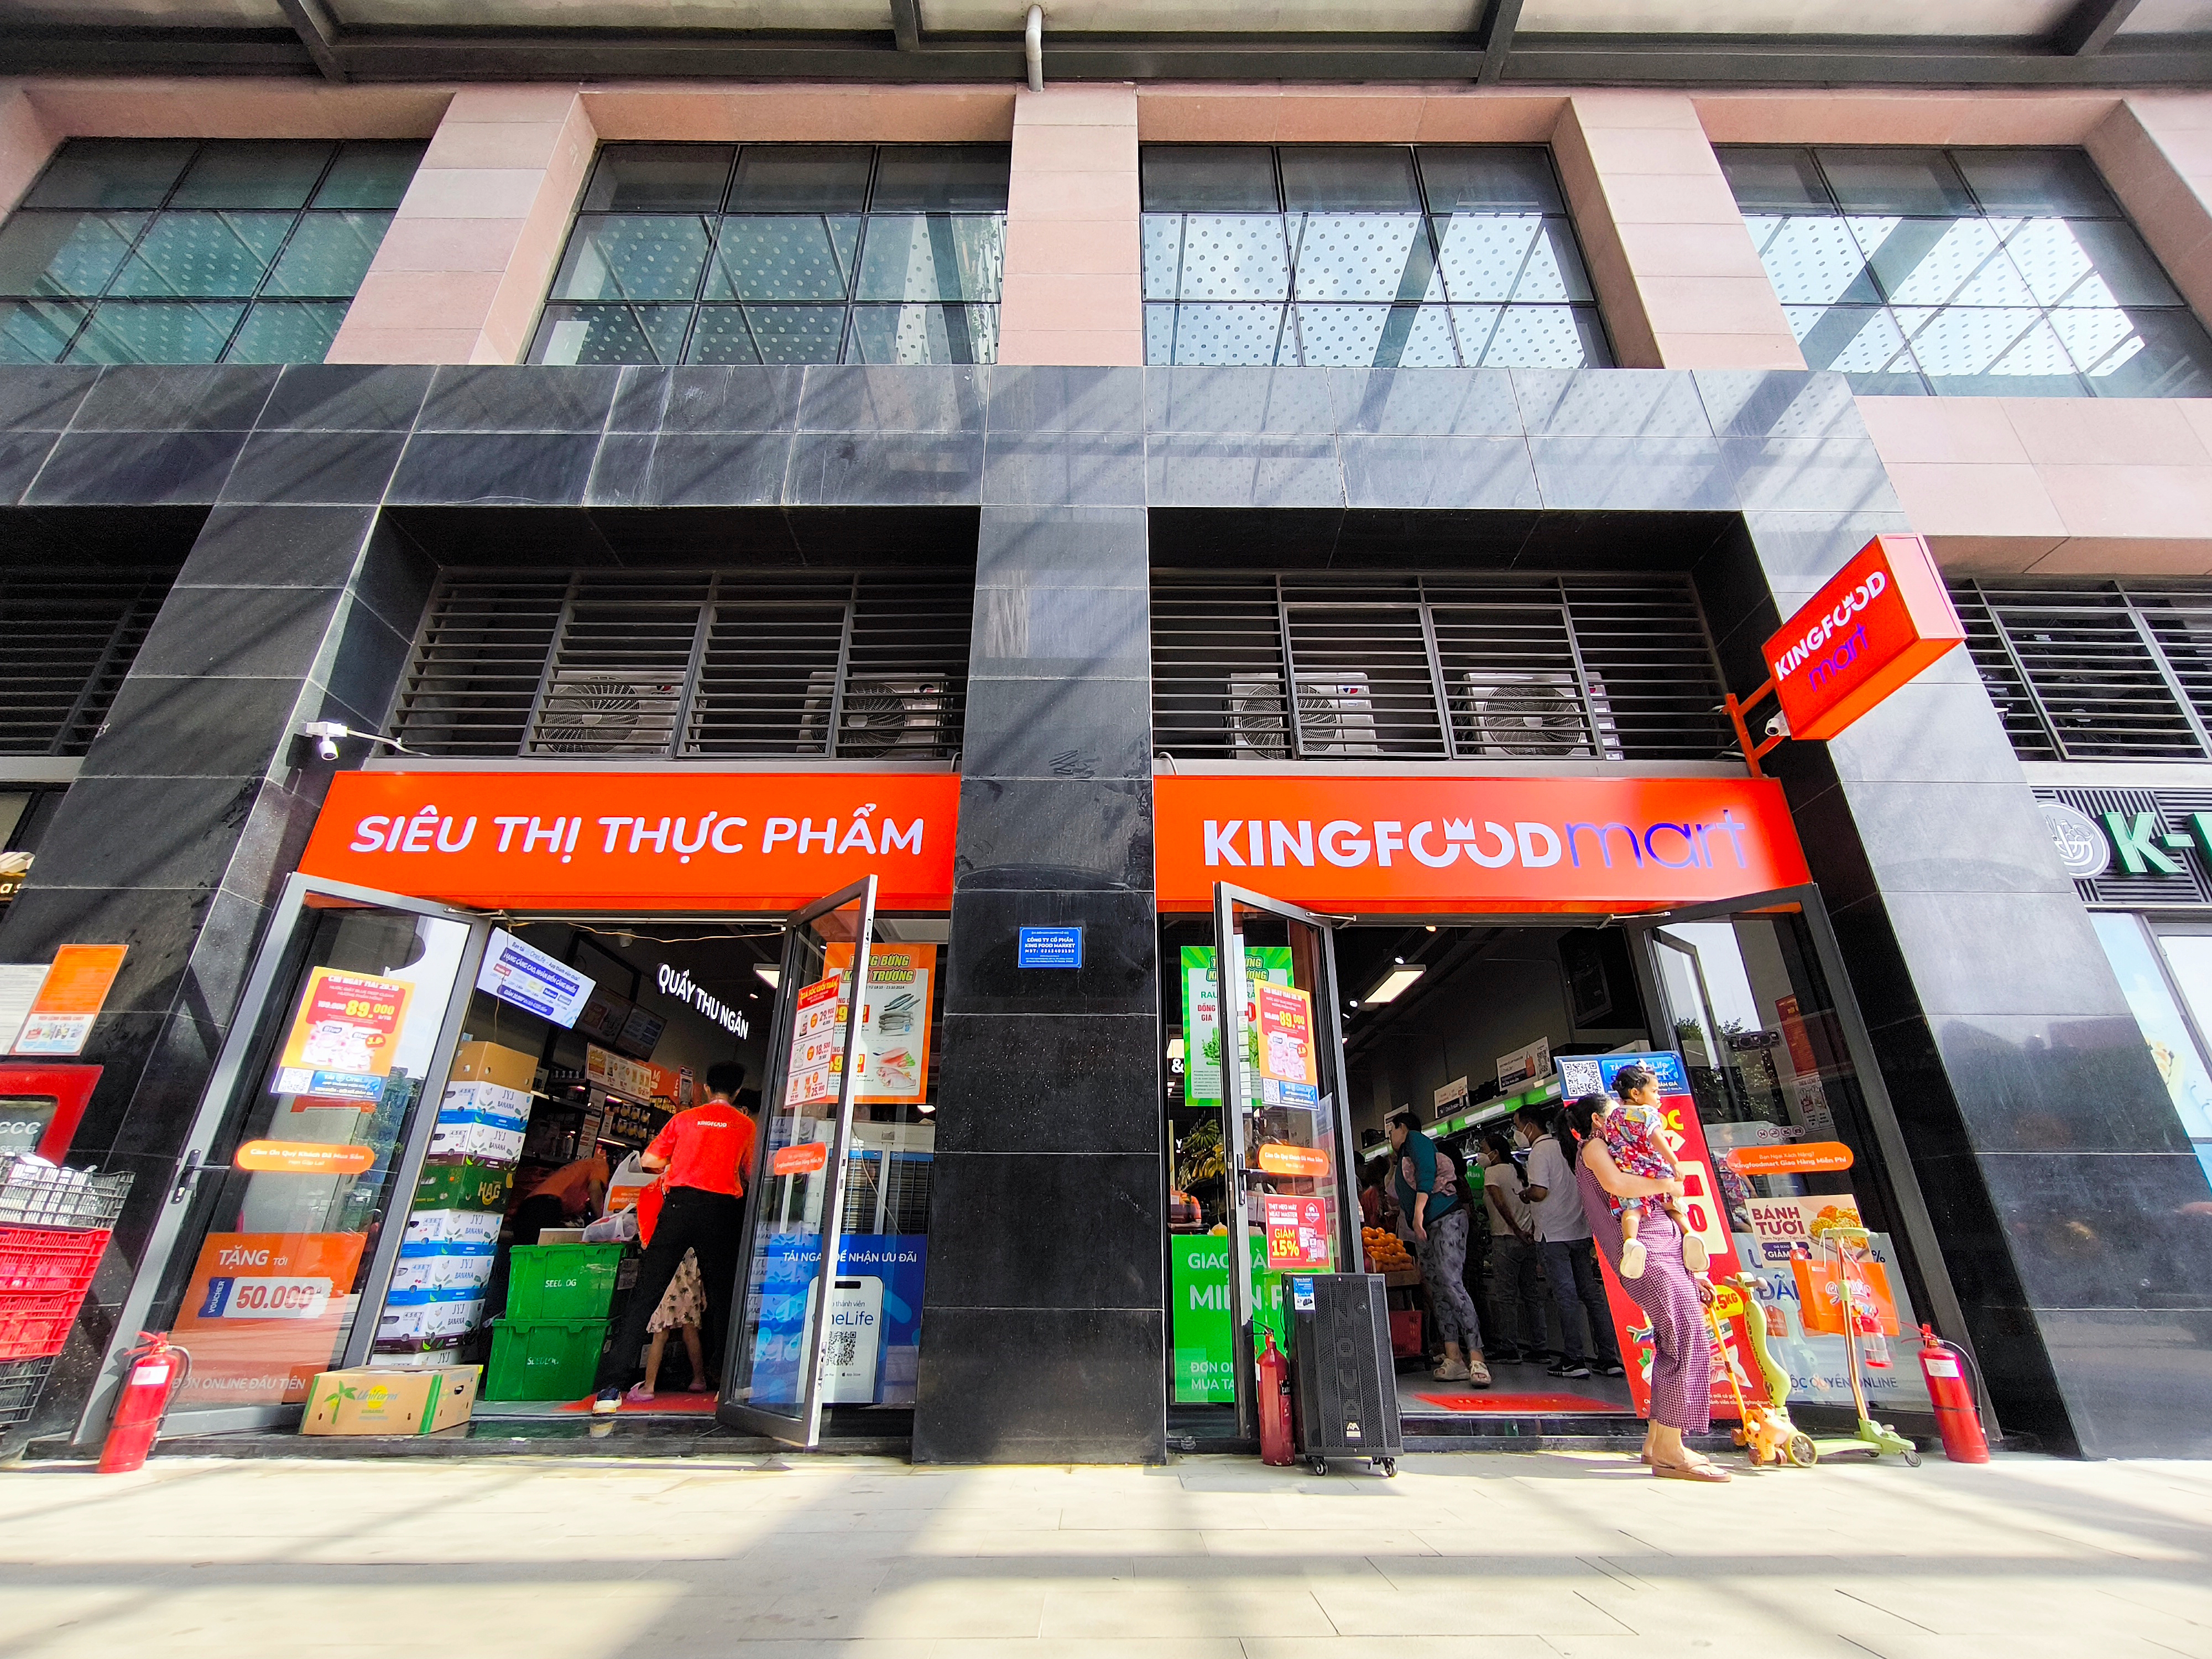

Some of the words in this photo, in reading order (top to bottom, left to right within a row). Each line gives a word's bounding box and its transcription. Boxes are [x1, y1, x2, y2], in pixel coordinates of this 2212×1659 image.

[1774, 571, 1885, 681] KINGFOOD
[1808, 623, 1868, 692] mart
[350, 805, 477, 852] SIÊU
[494, 816, 582, 863] THỊ
[598, 811, 748, 864] THỰC
[762, 803, 924, 855] PHẨM
[2104, 811, 2212, 873] K-
[696, 987, 720, 1020] THU
[719, 1005, 749, 1040] NGÂN
[497, 1100, 514, 1110] BANANA
[489, 1141, 506, 1151] BANANA
[1734, 1160, 1780, 1169] Kingfoodmart
[1797, 1157, 1815, 1166] Hàng
[1751, 1205, 1801, 1220] BÁNH
[1274, 1225, 1295, 1239] GIẢM
[1755, 1218, 1806, 1235] TƯƠI
[1271, 1240, 1300, 1256] 15%
[219, 1245, 270, 1270] TẶNG
[273, 1255, 288, 1265] TỚI
[782, 1249, 799, 1262] TẢI
[801, 1251, 822, 1262] NGA
[848, 1250, 879, 1265] NHẬN
[881, 1251, 896, 1262] ƯU
[898, 1250, 917, 1262] ĐÃI
[207, 1280, 225, 1314] VOUCHER
[202, 1378, 248, 1389] ONLINE
[279, 1375, 306, 1390] TIÊN
[1191, 1379, 1219, 1390] MUA
